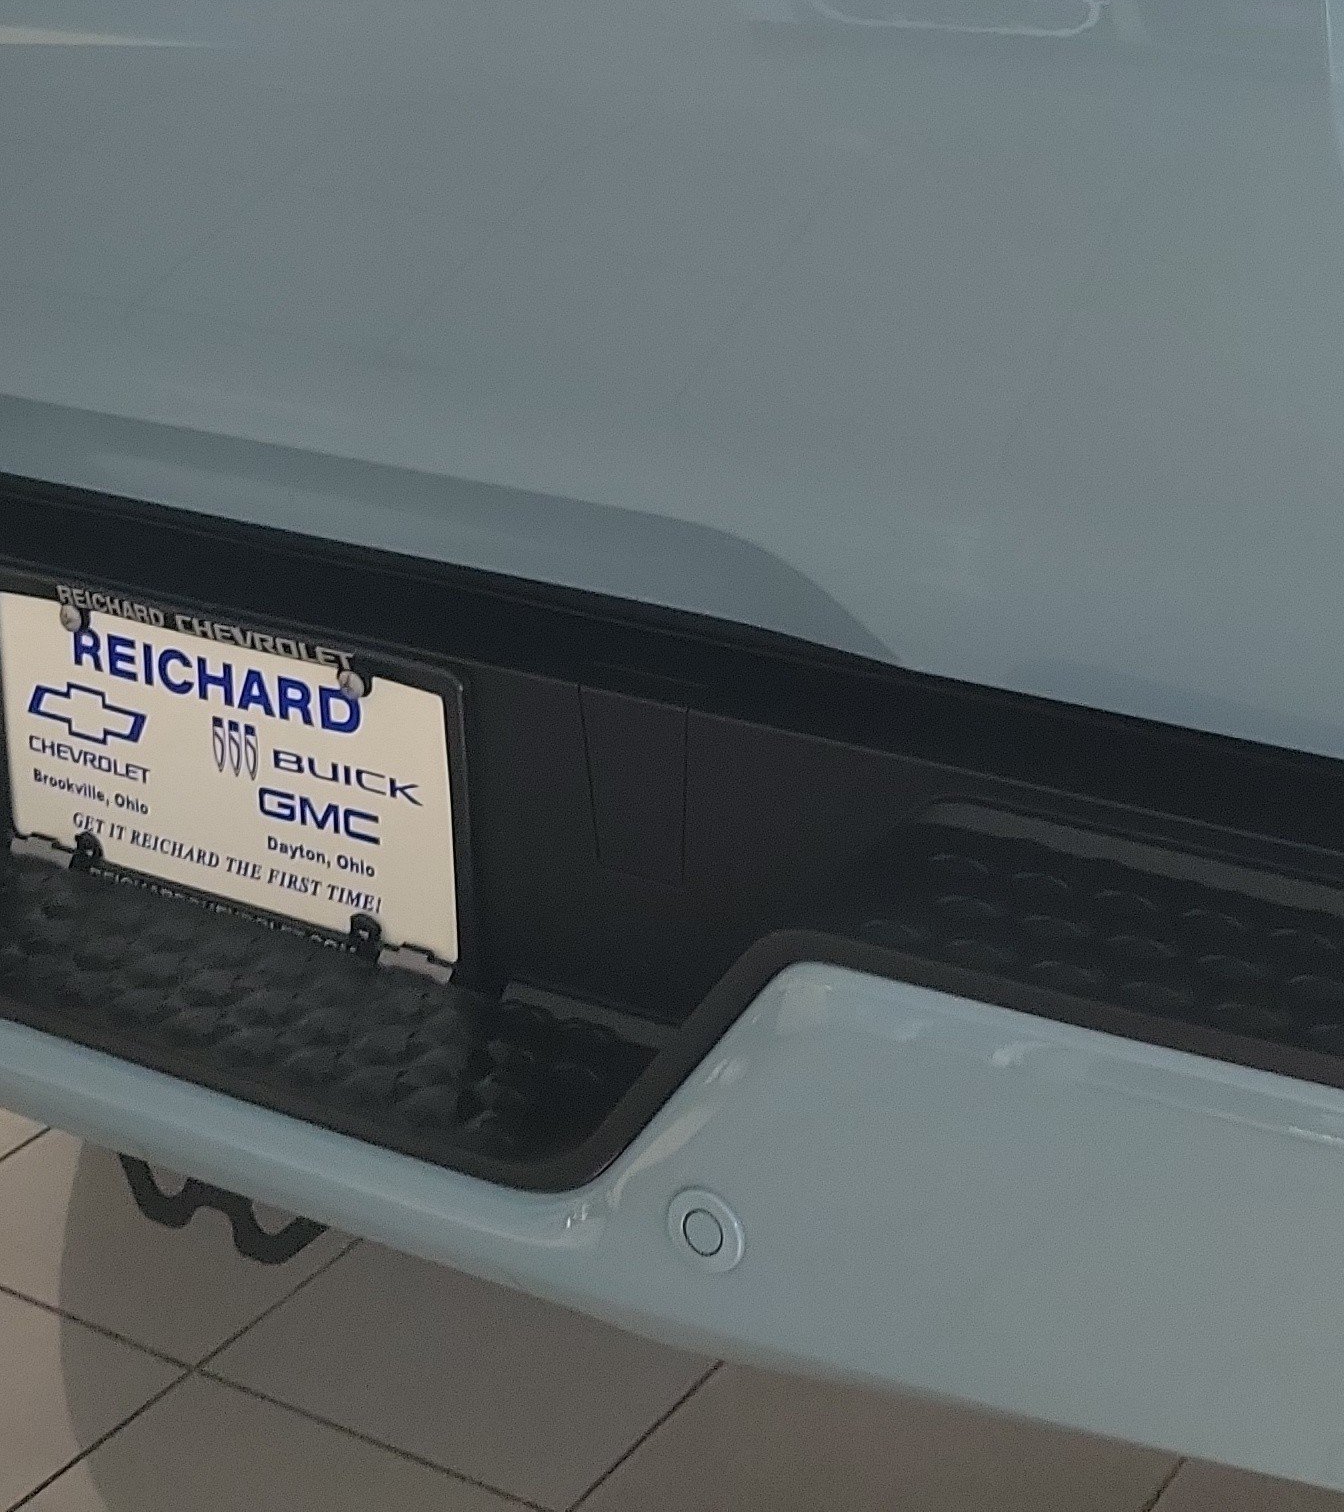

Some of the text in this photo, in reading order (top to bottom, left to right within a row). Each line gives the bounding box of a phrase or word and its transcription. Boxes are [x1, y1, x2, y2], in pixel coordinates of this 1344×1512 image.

[56, 584, 355, 670] REICHARD CHEVROLET
[73, 626, 362, 734] REICHARD
[29, 734, 151, 784] CHEVROLET
[273, 748, 423, 807] BUICK
[33, 767, 150, 815] Brookville, Ohio
[258, 786, 381, 846] GMC
[72, 811, 383, 915] GET IT REICHARD THE FIRST TIME!
[267, 835, 376, 878] Dayton, Ohio
